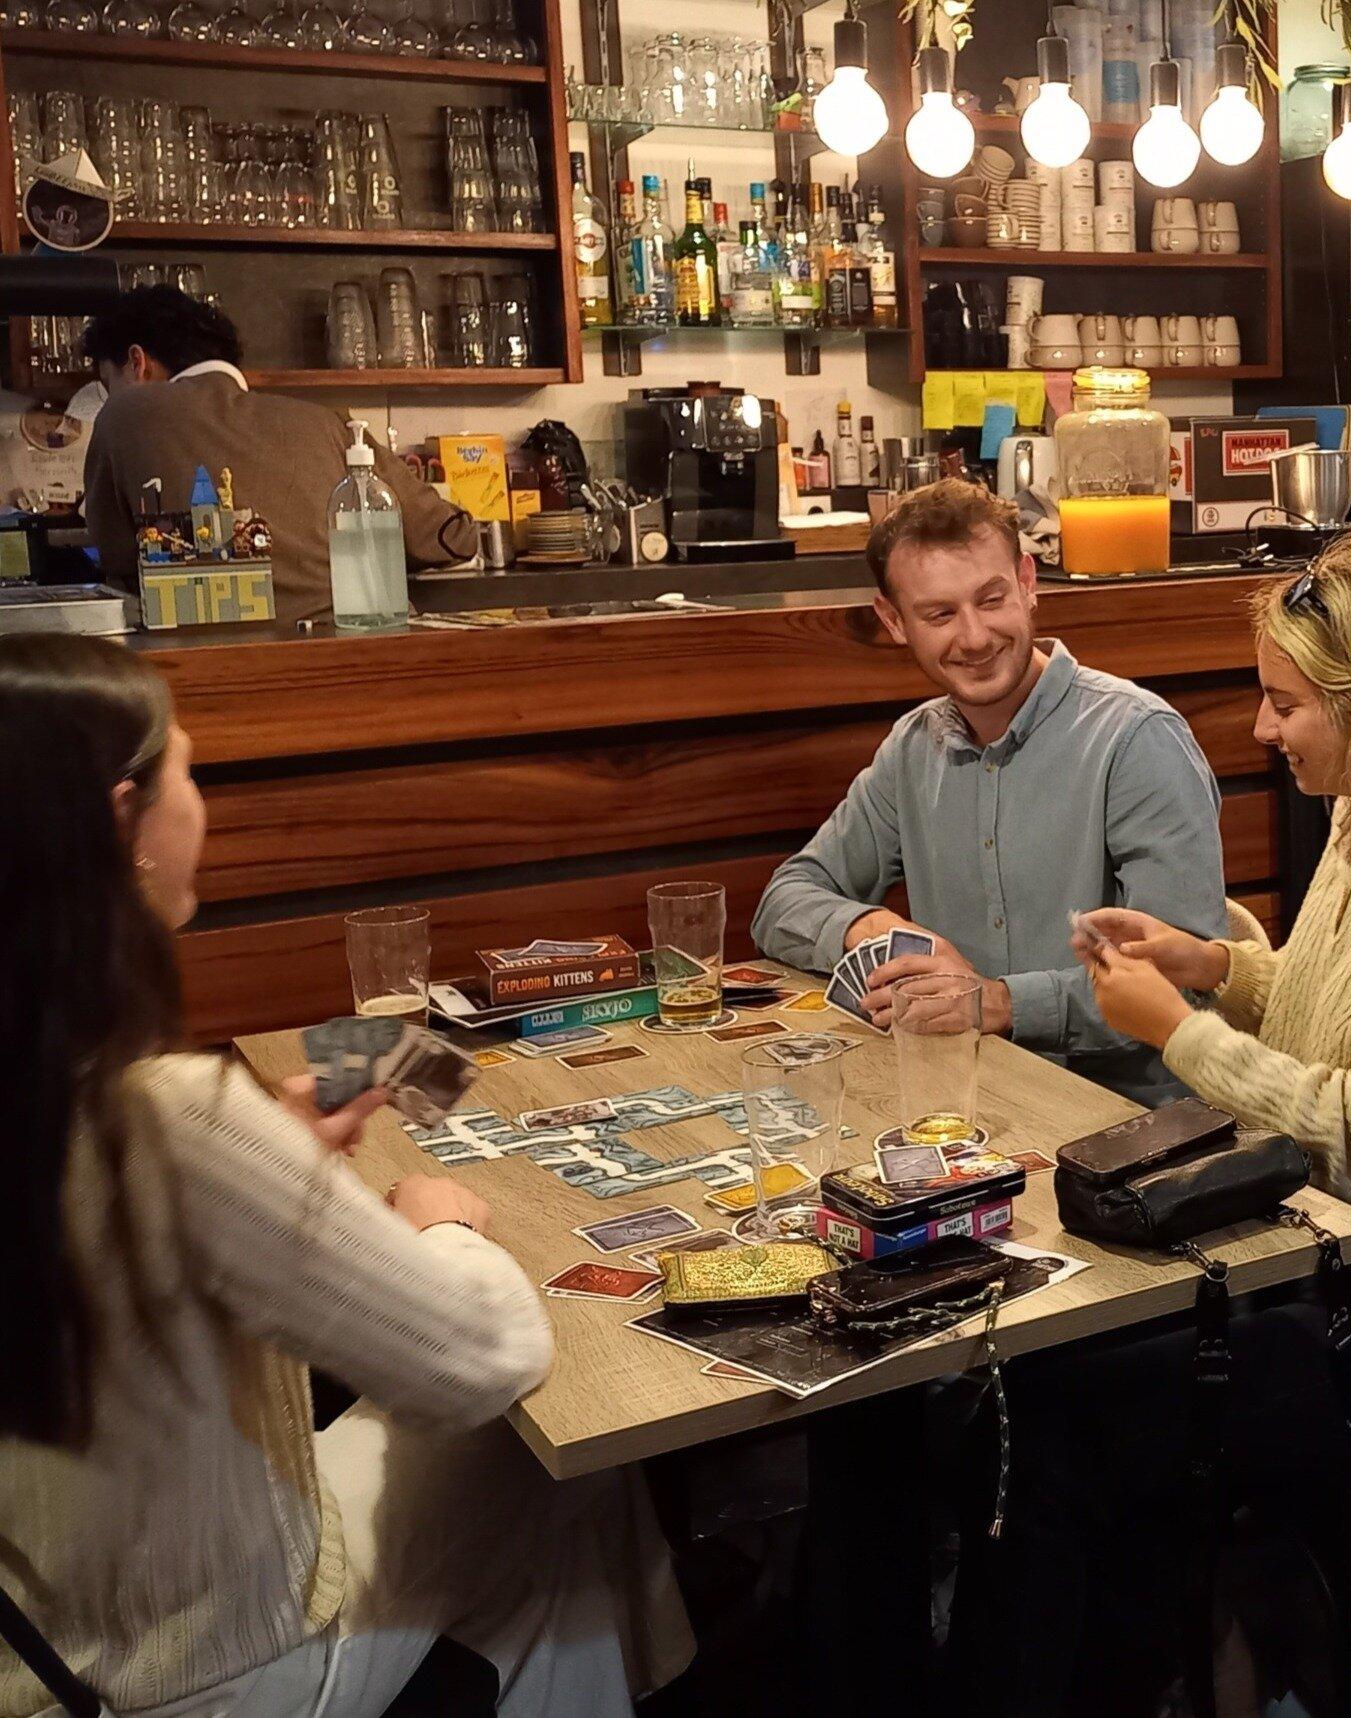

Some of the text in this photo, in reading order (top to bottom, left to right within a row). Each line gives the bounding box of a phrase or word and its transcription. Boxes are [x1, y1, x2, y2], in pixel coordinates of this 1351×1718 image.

[144, 577, 270, 630] TIPS
[497, 970, 594, 994] EXPLODING KITTENS
[581, 998, 632, 1021] SKYJO
[834, 1223, 855, 1238] THAT'S
[944, 1217, 967, 1233] THAT'S
